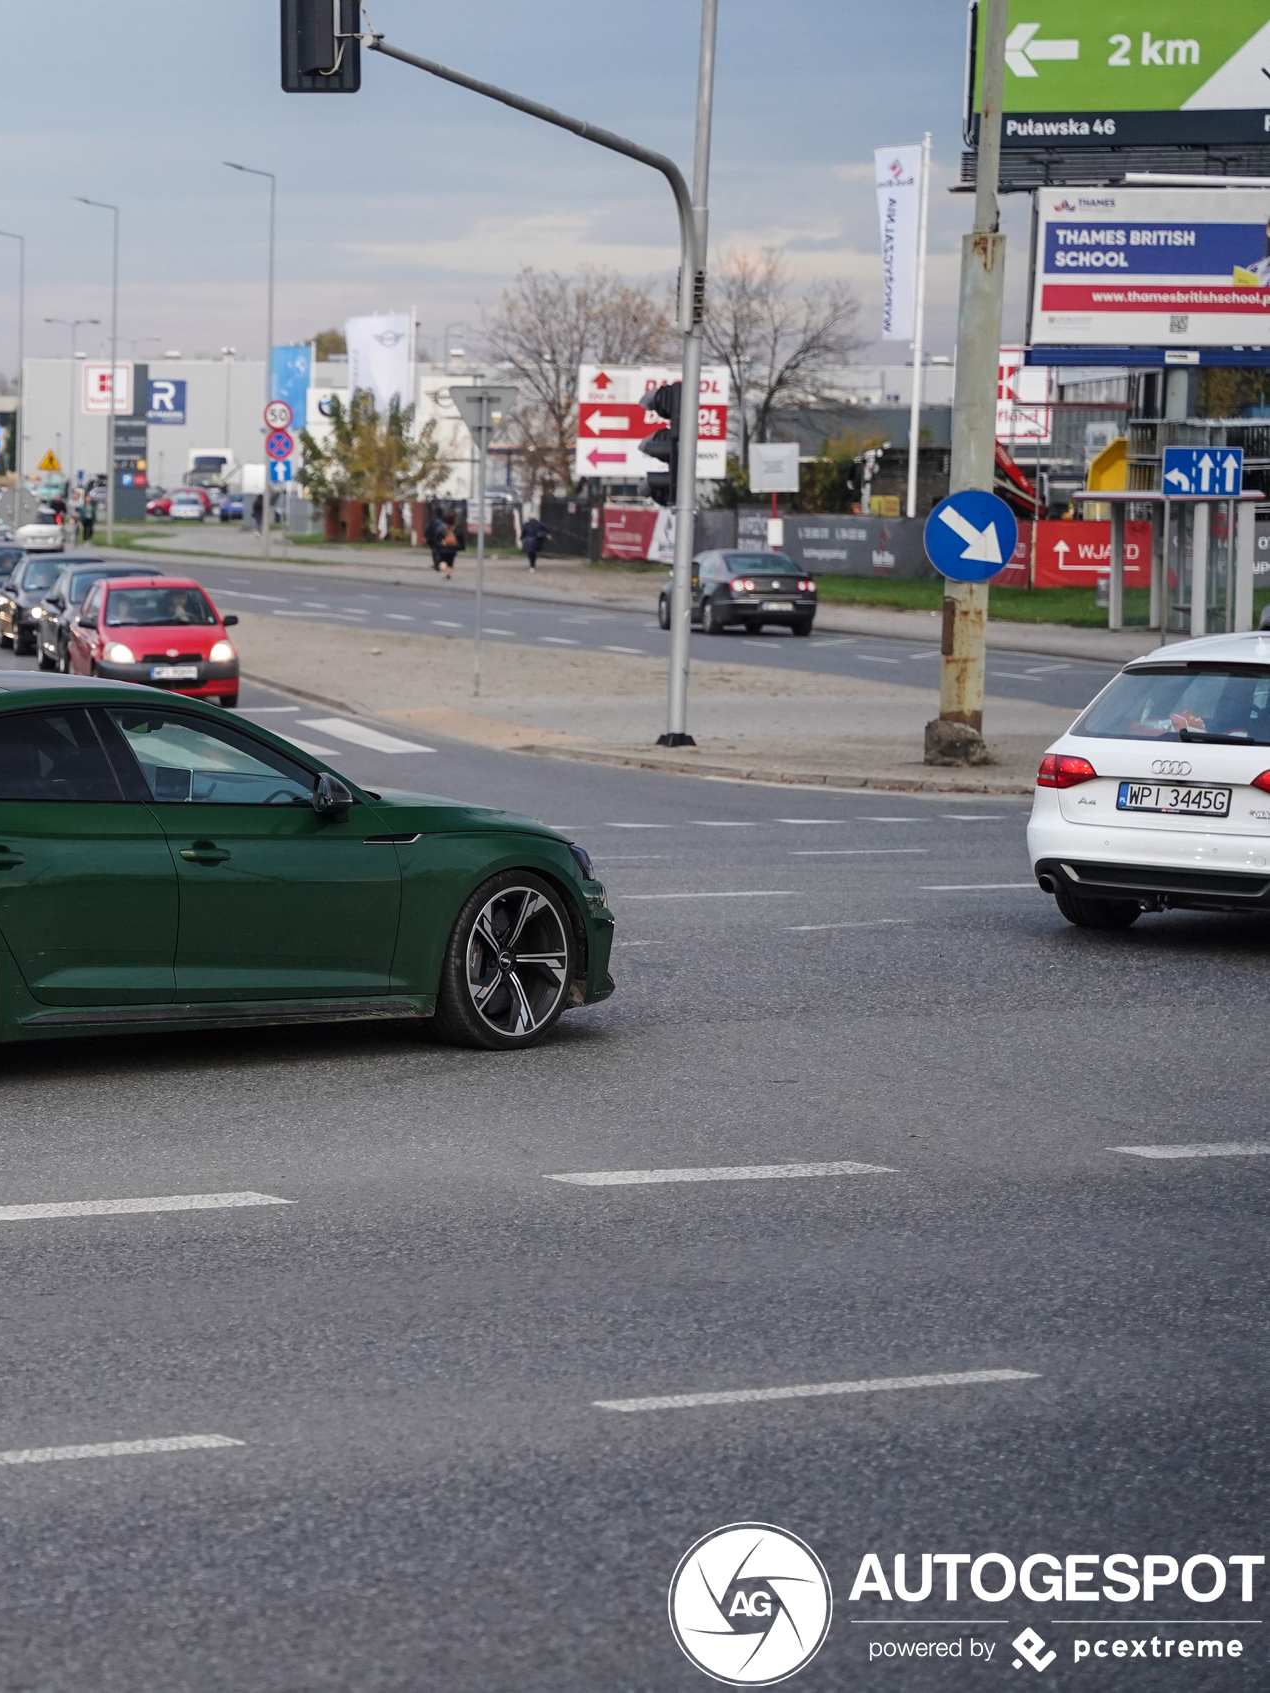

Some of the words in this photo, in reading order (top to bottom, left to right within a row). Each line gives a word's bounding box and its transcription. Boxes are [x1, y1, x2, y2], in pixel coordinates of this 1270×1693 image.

[1107, 34, 1131, 66] 2
[1141, 31, 1200, 65] km
[1006, 118, 1090, 137] Puławska
[1092, 118, 1116, 136] 46
[1078, 198, 1116, 207] THAMES
[1056, 229, 1126, 246] THAMES
[1130, 230, 1196, 246] BRITISH
[1055, 251, 1128, 268] SCHOOL
[645, 379, 721, 393] DOL
[152, 381, 176, 410] R
[269, 408, 288, 422] 50
[643, 409, 721, 425] DOL
[1077, 543, 1140, 560] WJAD
[1077, 796, 1097, 806] A4
[1129, 786, 1161, 806] WPI
[1169, 789, 1226, 811] 3445G
